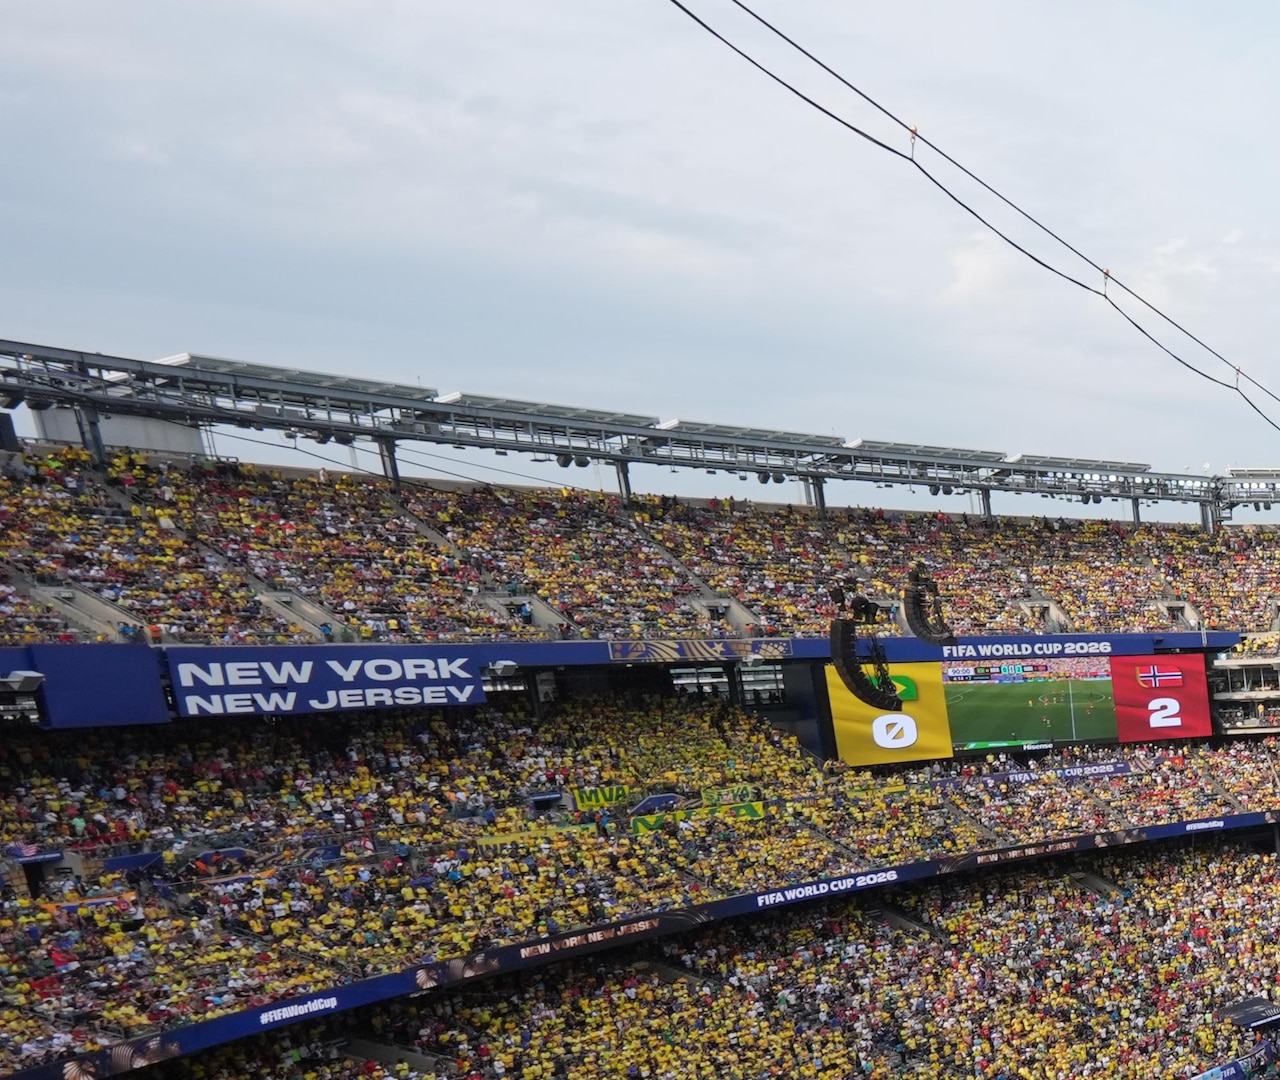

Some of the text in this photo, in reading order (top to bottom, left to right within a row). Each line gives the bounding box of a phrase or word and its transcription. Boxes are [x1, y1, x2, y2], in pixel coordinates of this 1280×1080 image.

[943, 641, 1112, 658] FIFA WORLD CUP 2026
[178, 657, 473, 687] NEW YORK
[185, 685, 475, 715] NEW JERSEY
[1147, 697, 1182, 728] 2
[1023, 743, 1053, 751] Hisense
[1084, 764, 1114, 774] 2026
[757, 870, 898, 907] FIFA WORLD CUP 2026
[520, 918, 660, 959] NEW YORK NEW JERSEY
[260, 997, 338, 1025] #FIFAWorldCup
